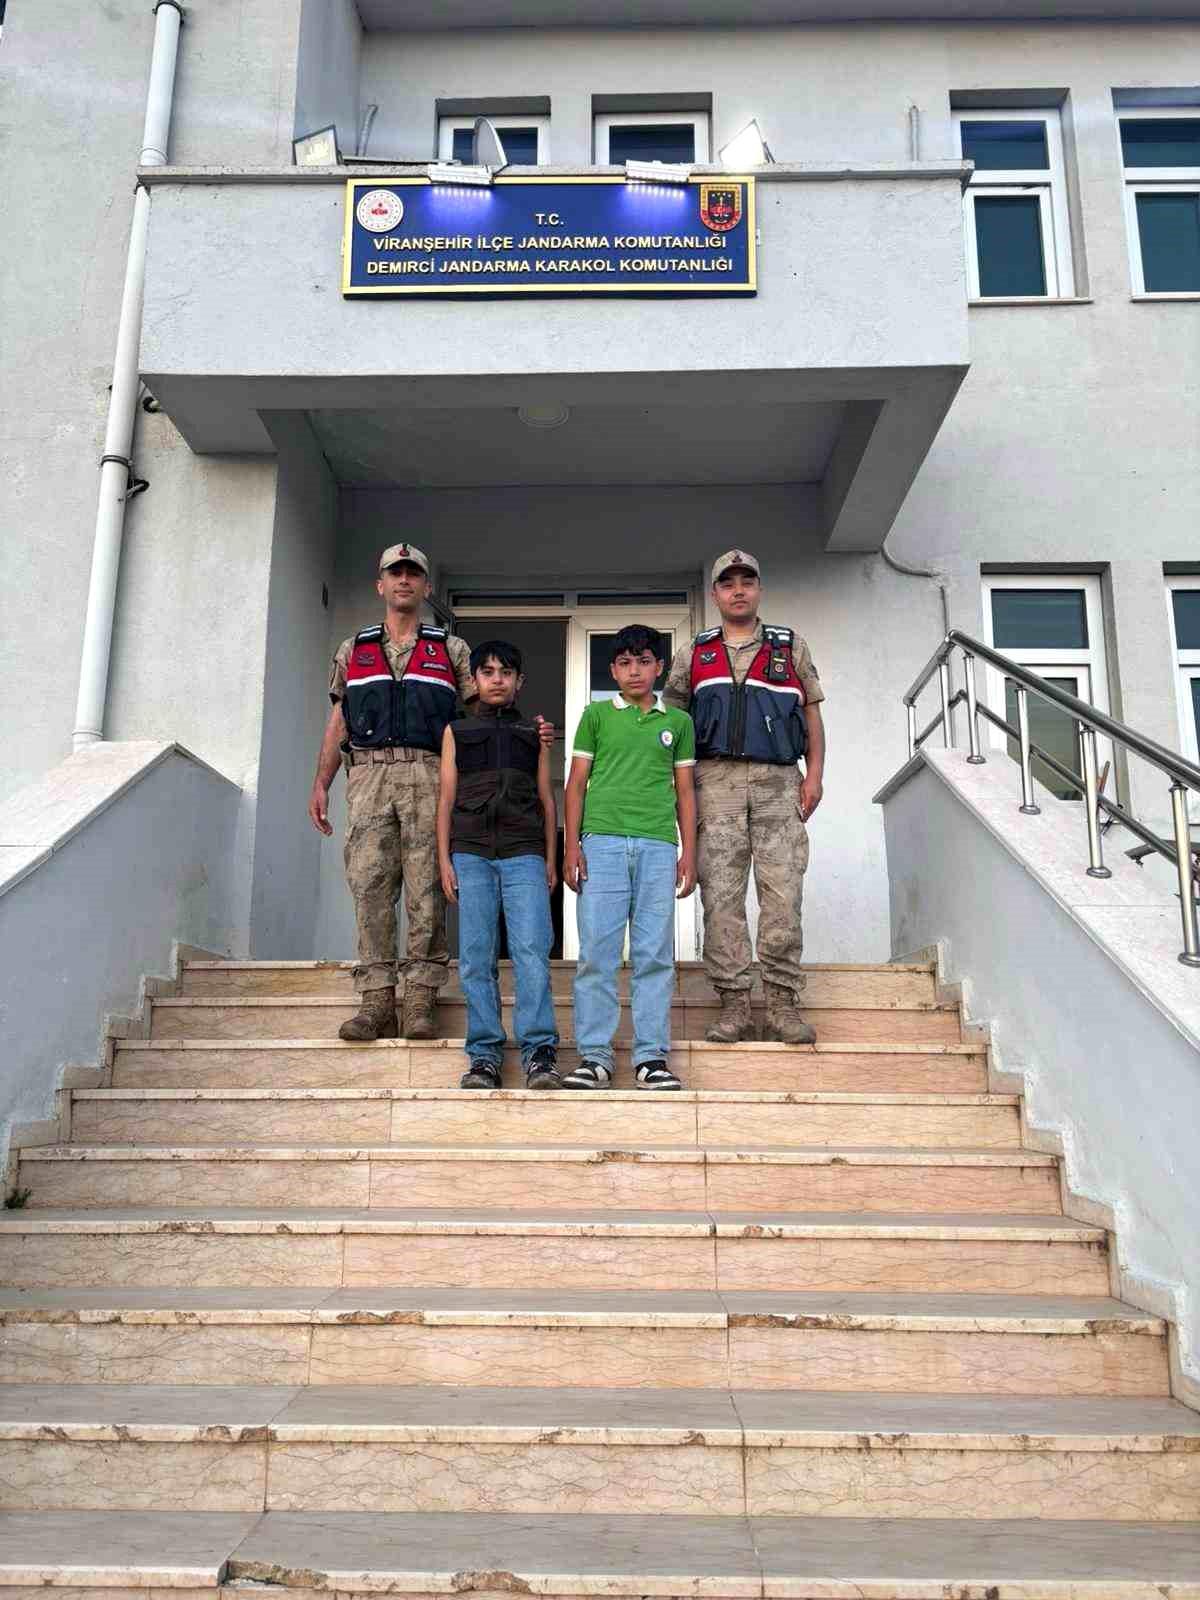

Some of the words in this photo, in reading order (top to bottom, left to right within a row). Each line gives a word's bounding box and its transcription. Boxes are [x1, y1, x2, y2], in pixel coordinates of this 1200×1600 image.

[536, 213, 564, 225] T.C.
[374, 235, 472, 252] VİRANŞEHİR
[477, 235, 513, 251] İLÇE
[518, 236, 609, 249] JANDARMA
[614, 233, 726, 249] KOMUTANLIĞI
[440, 260, 531, 273] JANDARMA
[535, 259, 615, 272] KARAKOL
[620, 257, 733, 271] KOMUTANLIĞI
